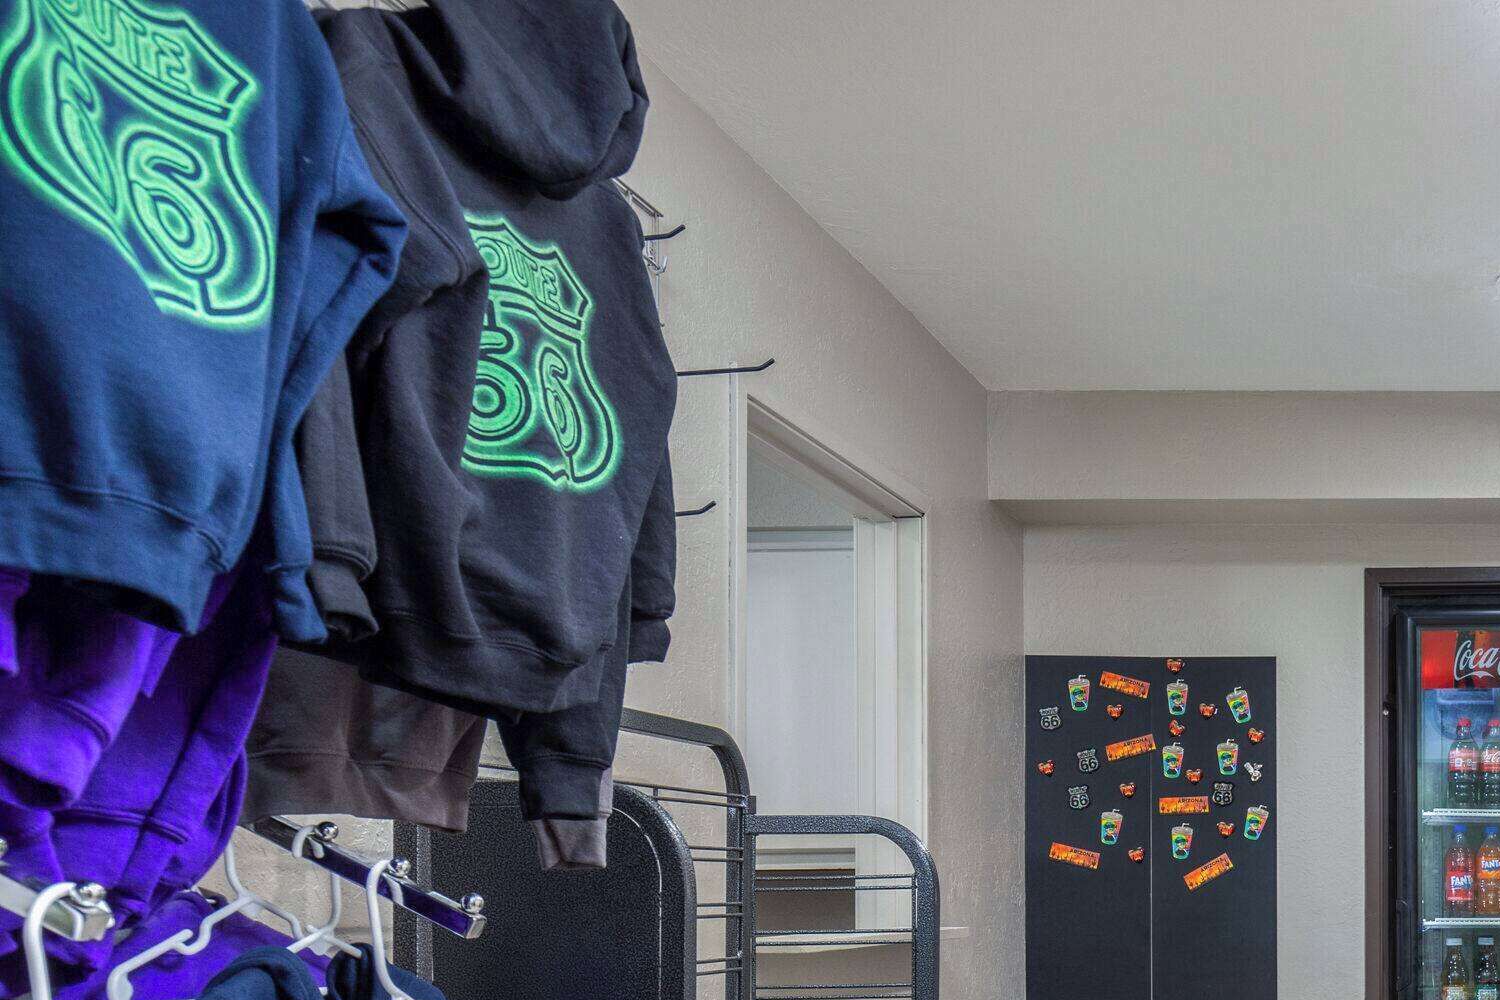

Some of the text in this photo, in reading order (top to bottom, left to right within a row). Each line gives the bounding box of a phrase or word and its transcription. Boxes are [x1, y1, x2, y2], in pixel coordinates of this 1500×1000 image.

[474, 235, 560, 312] OUTE
[1042, 716, 1061, 728] 66
[1081, 760, 1097, 772] 66
[1071, 796, 1088, 807] 66
[1214, 791, 1232, 802] 66
